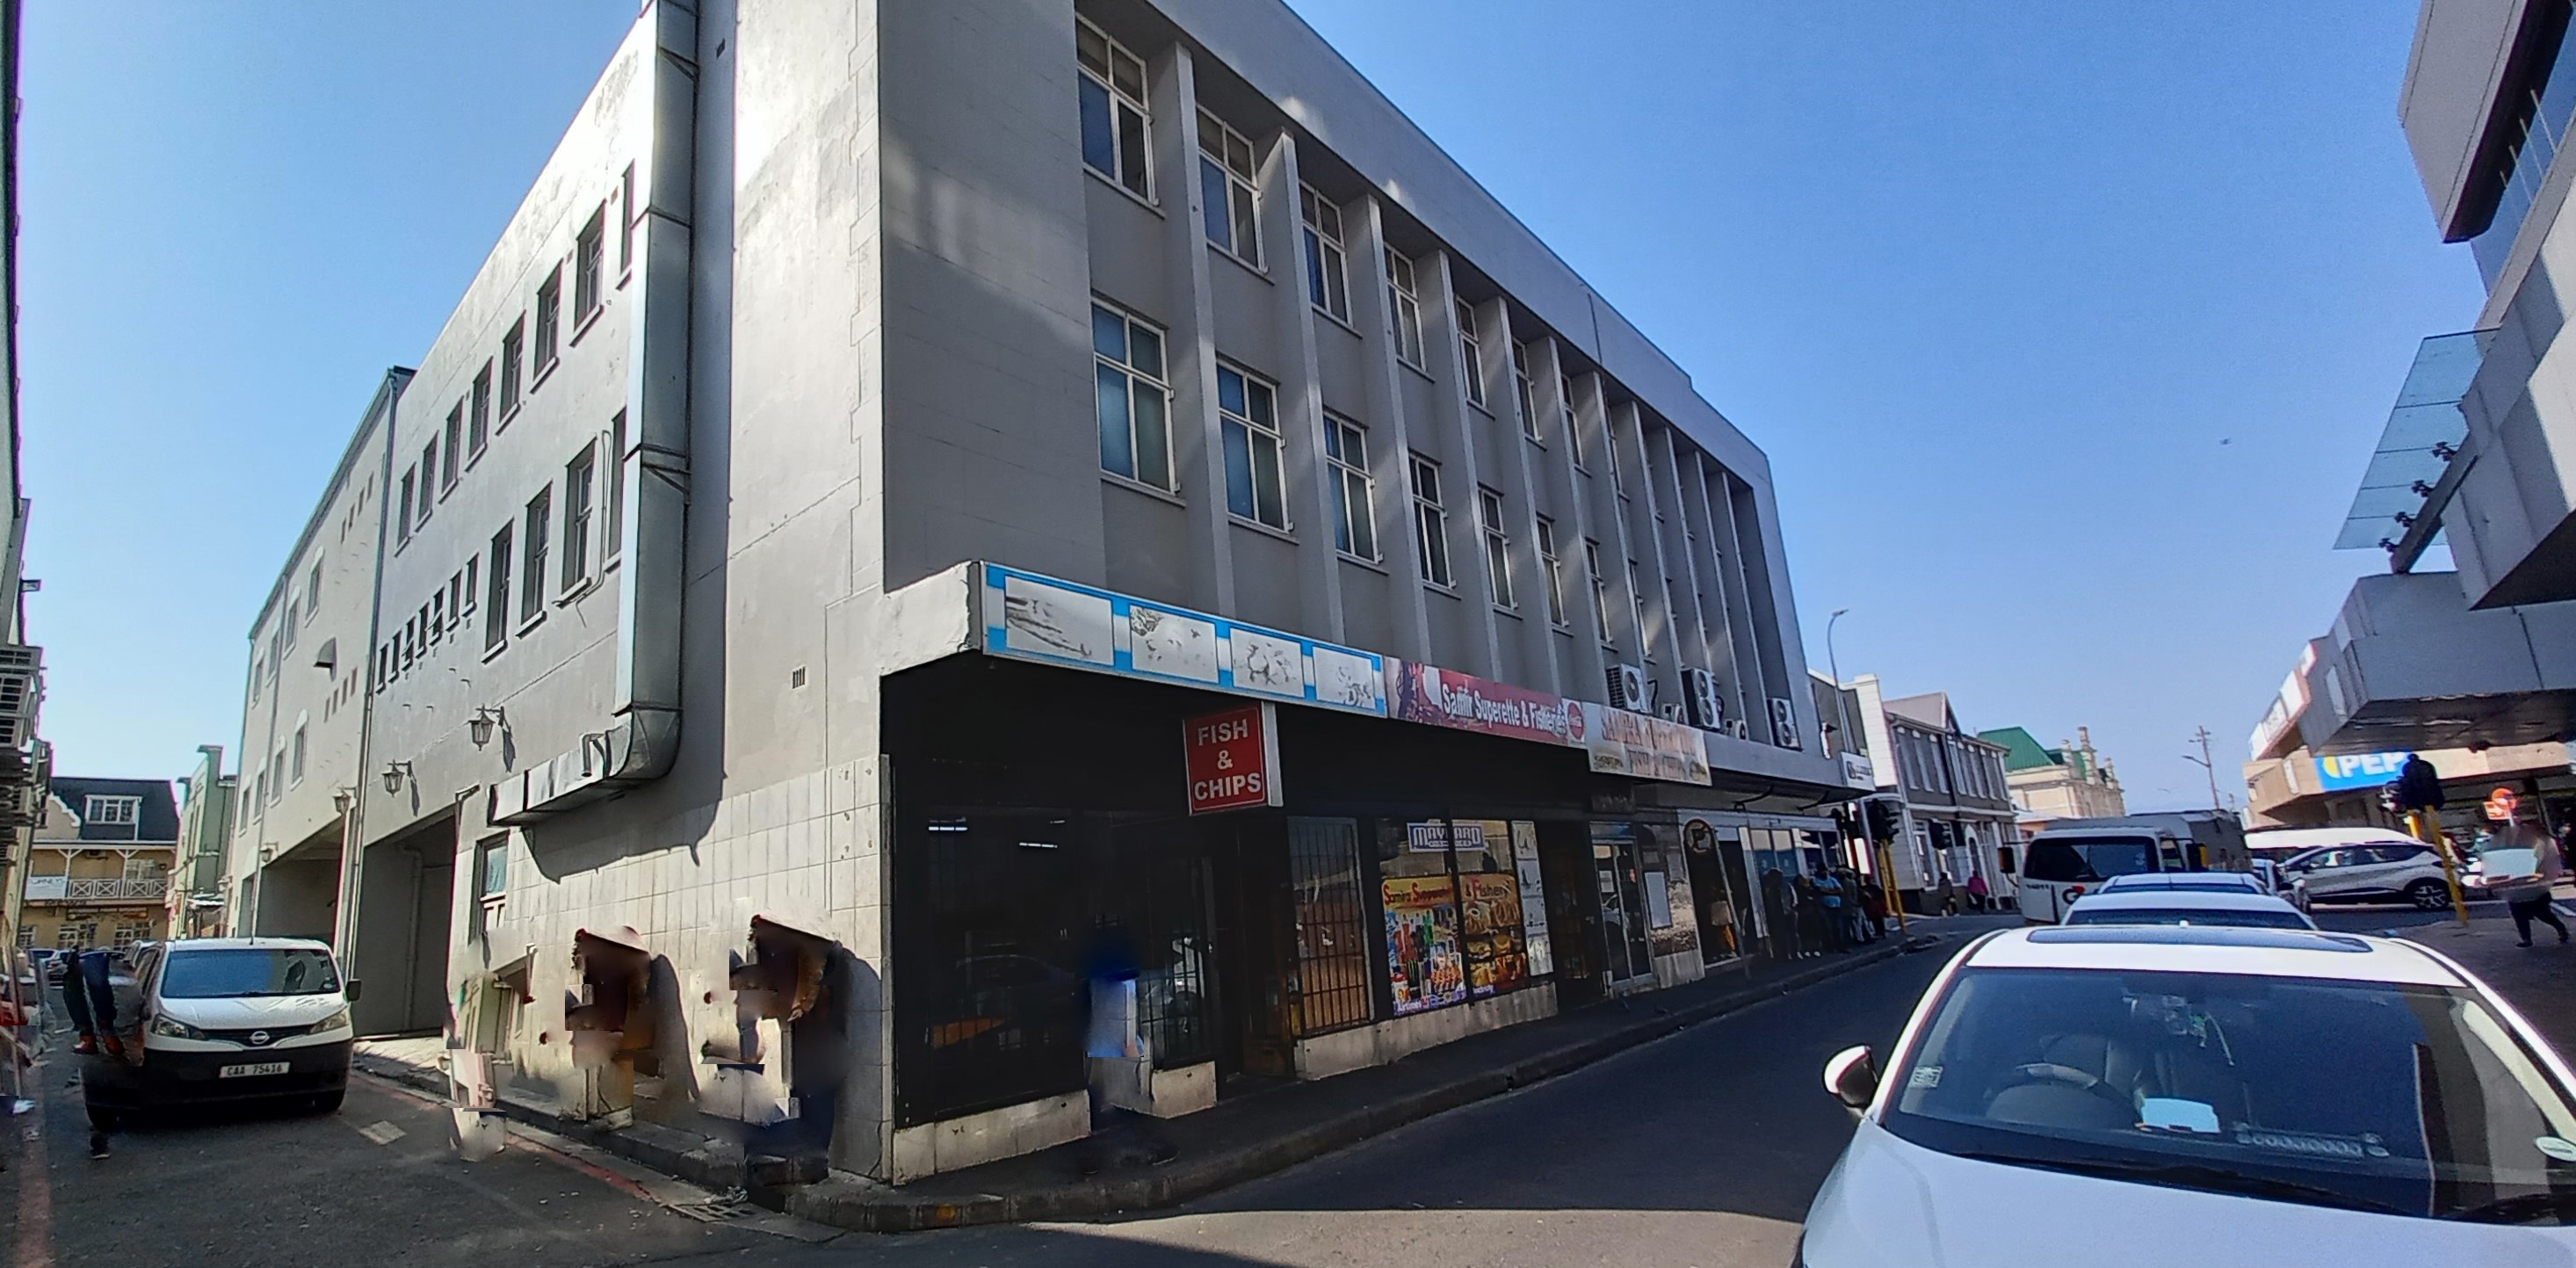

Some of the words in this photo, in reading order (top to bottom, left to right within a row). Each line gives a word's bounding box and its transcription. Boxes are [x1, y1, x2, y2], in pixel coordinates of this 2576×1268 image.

[1474, 689, 1521, 728] Superette
[1521, 700, 1530, 728] &
[1198, 719, 1248, 746] FISH
[1217, 750, 1234, 770] &
[2339, 752, 2407, 777] PEP
[1194, 772, 1262, 801] CHIPS
[1414, 826, 1481, 846] MAYARD
[227, 1066, 246, 1076] CAA
